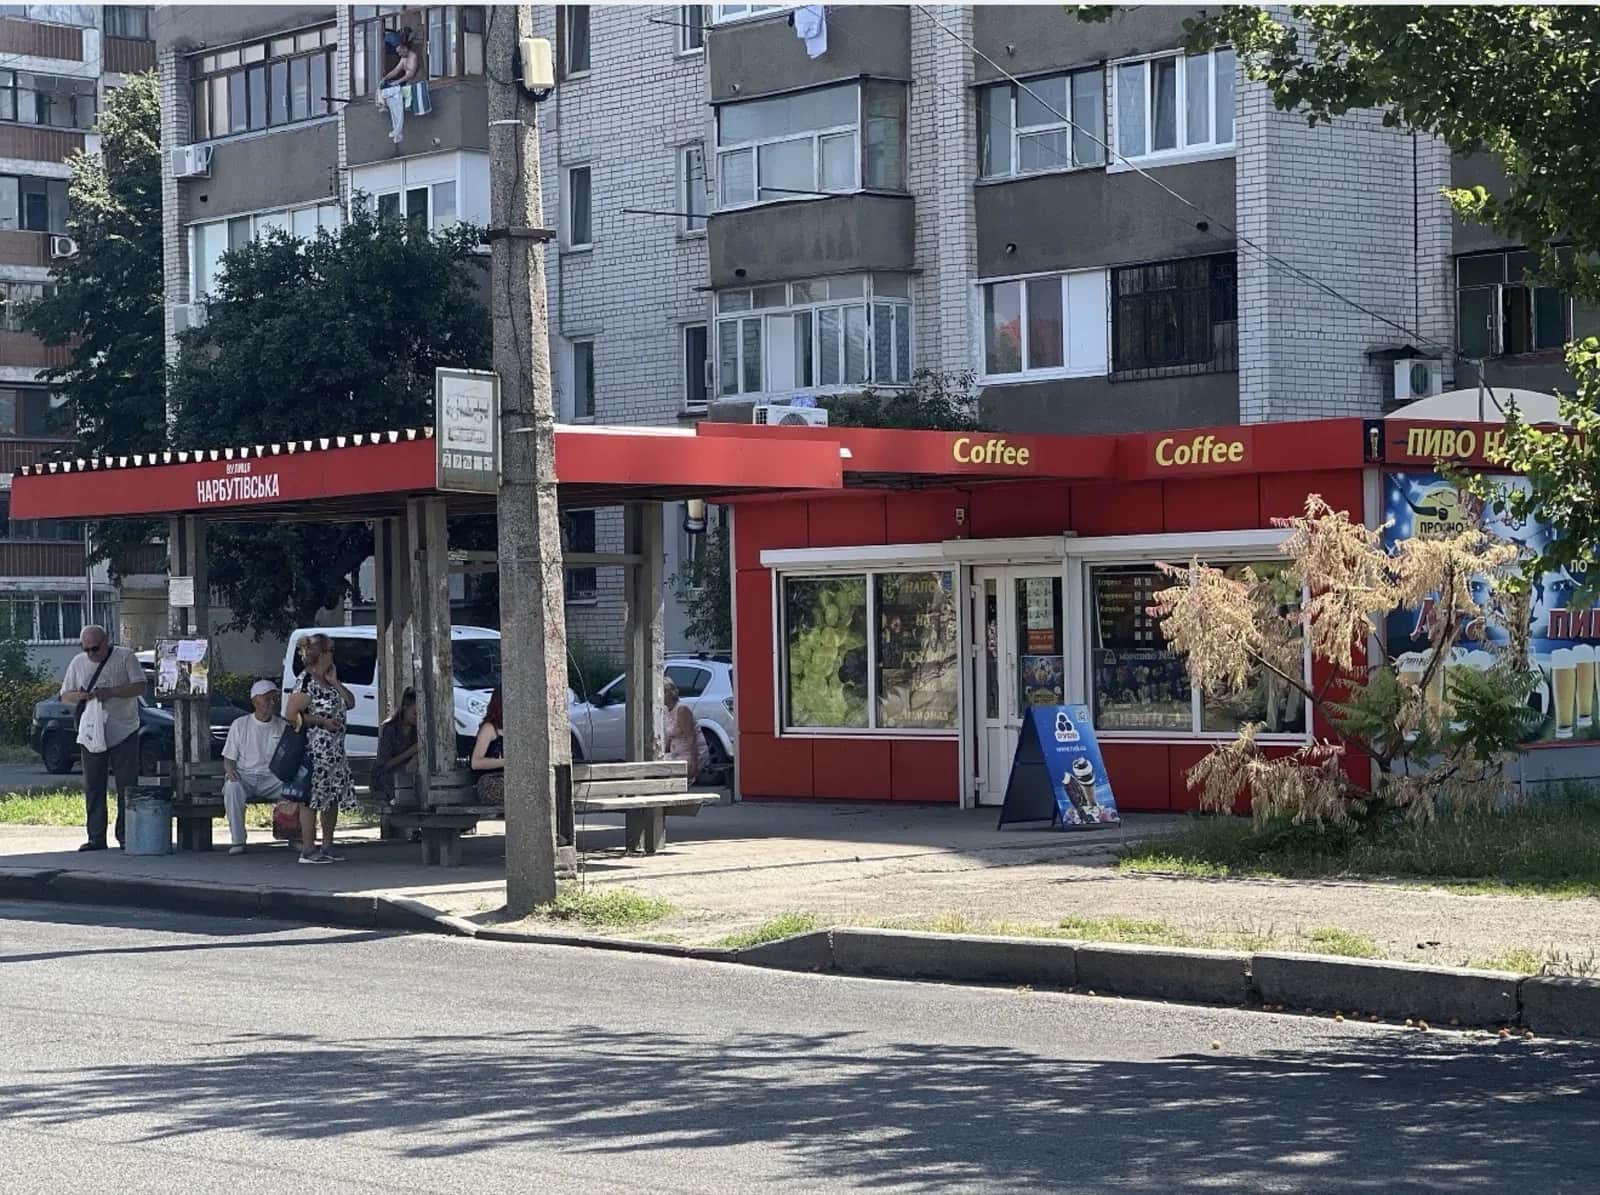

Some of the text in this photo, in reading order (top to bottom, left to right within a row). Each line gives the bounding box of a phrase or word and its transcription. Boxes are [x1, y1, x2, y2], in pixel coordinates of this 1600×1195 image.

[953, 438, 1030, 466] Coffee
[1155, 435, 1244, 466] Coffee
[1406, 427, 1476, 458] ПИВО
[197, 473, 280, 503] НАРБУТІВСЬКА
